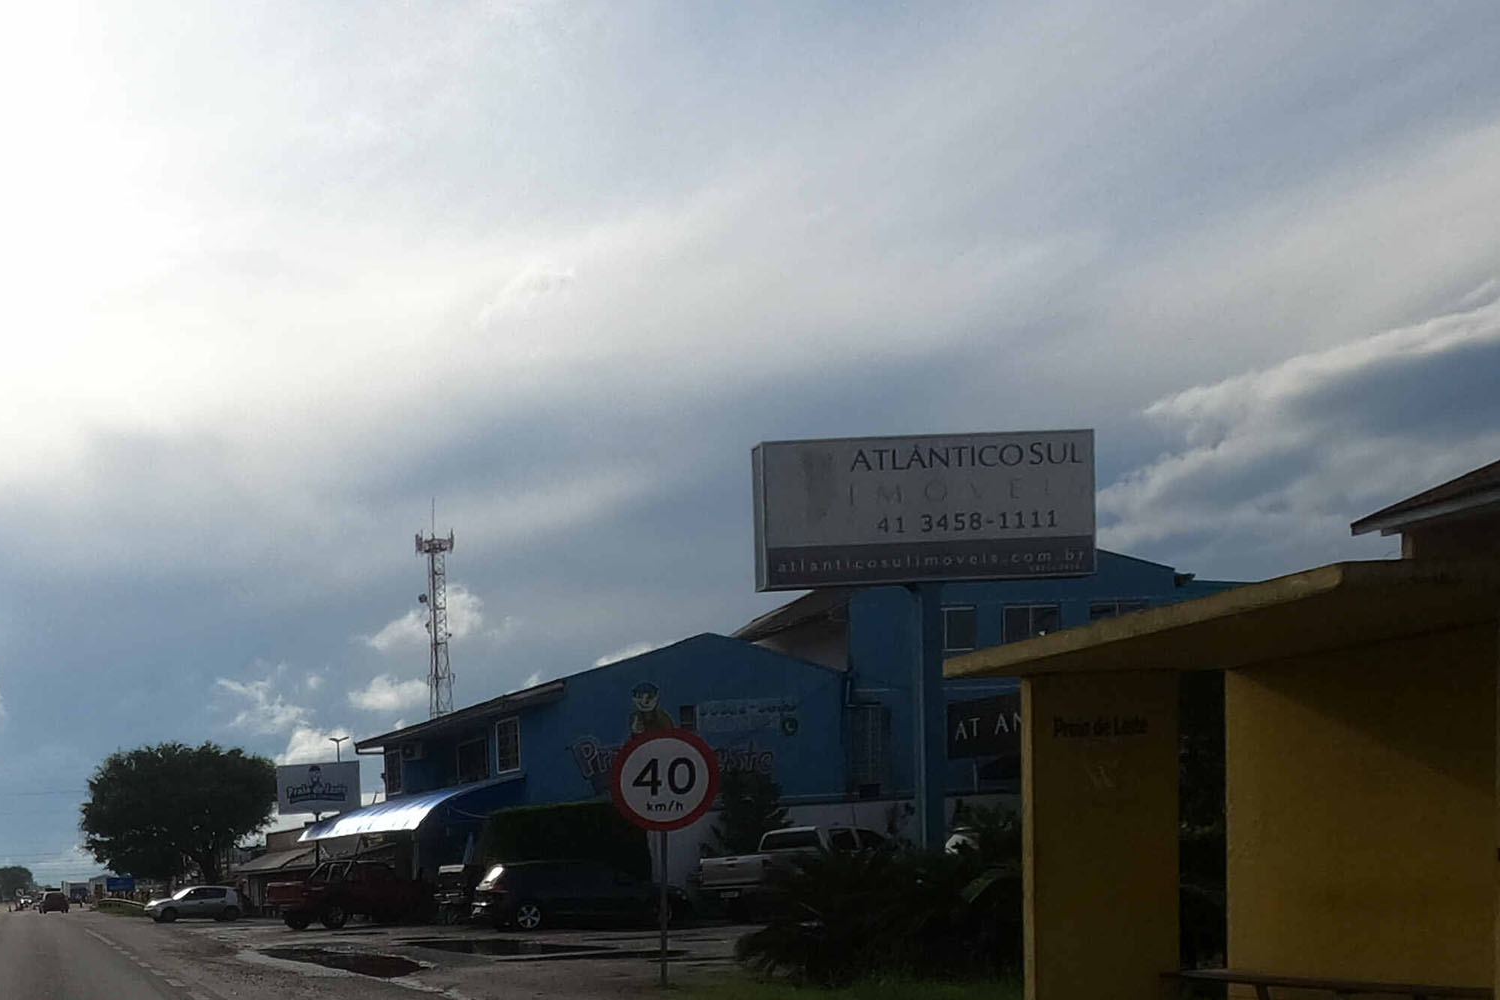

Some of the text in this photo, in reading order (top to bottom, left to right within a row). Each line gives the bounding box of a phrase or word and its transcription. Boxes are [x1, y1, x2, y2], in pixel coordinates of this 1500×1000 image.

[877, 509, 1059, 534] 41 3458-1111
[632, 757, 696, 796] 40
[646, 800, 684, 812] km/h
